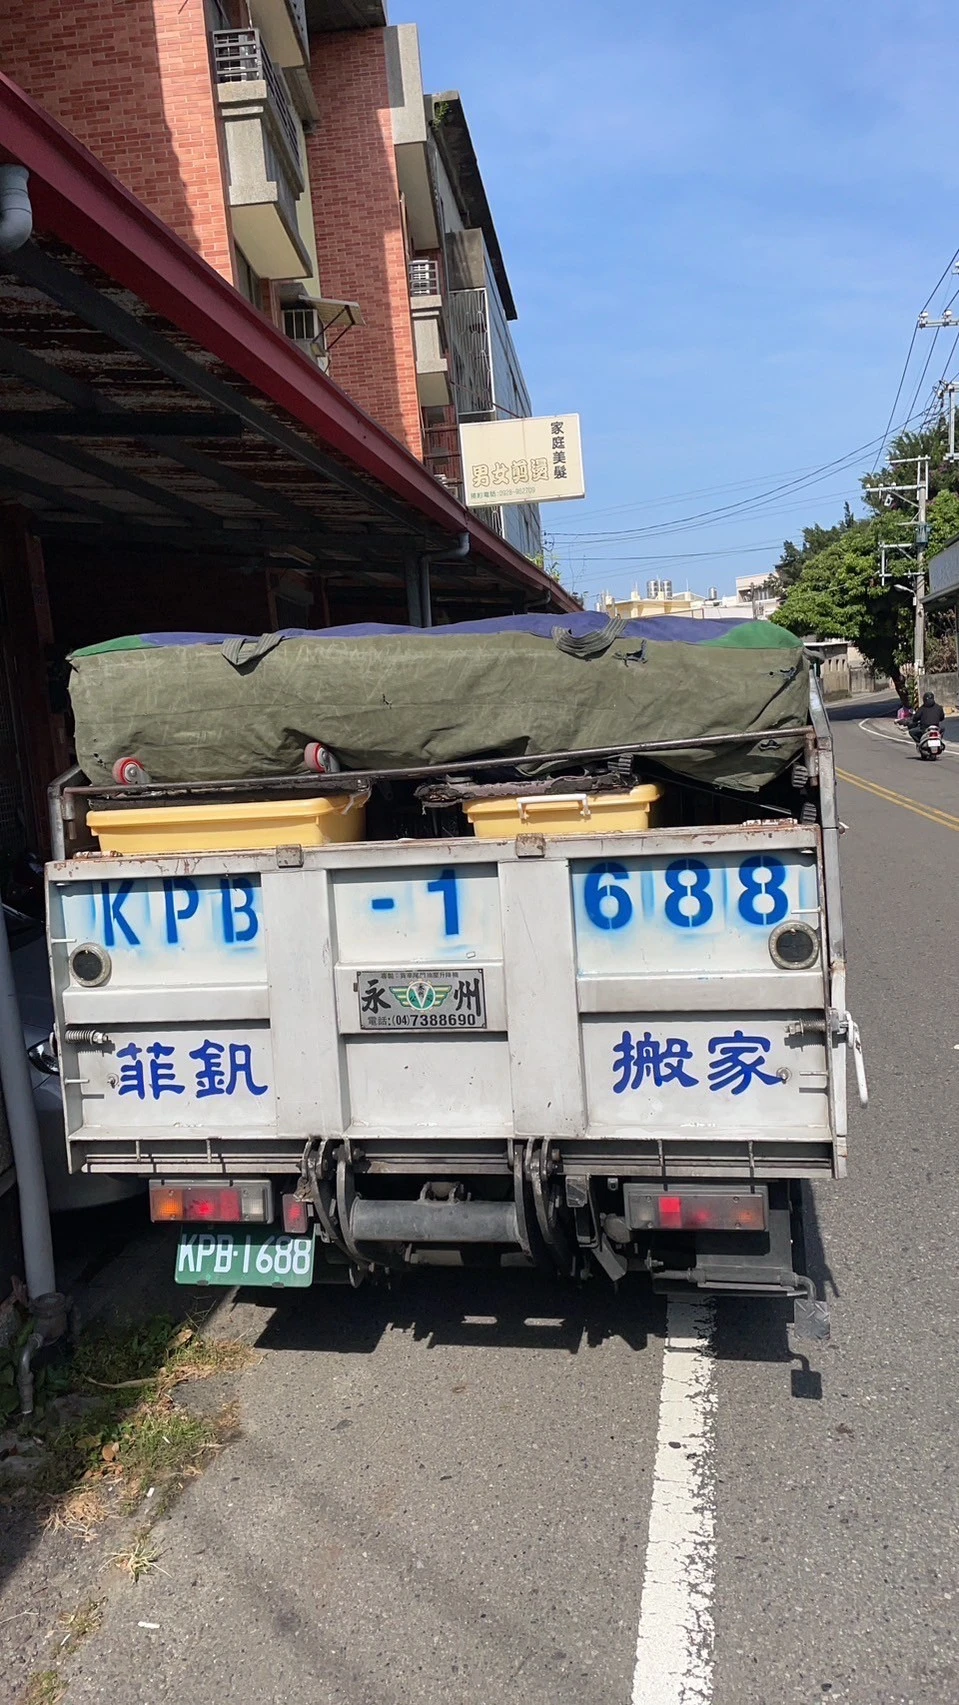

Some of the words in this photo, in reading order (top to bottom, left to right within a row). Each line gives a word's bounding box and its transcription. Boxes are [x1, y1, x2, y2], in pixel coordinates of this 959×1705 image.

[472, 457, 550, 488] 男女剪燙
[551, 421, 567, 480] 家庭美髮
[612, 1029, 785, 1095] 搬家
